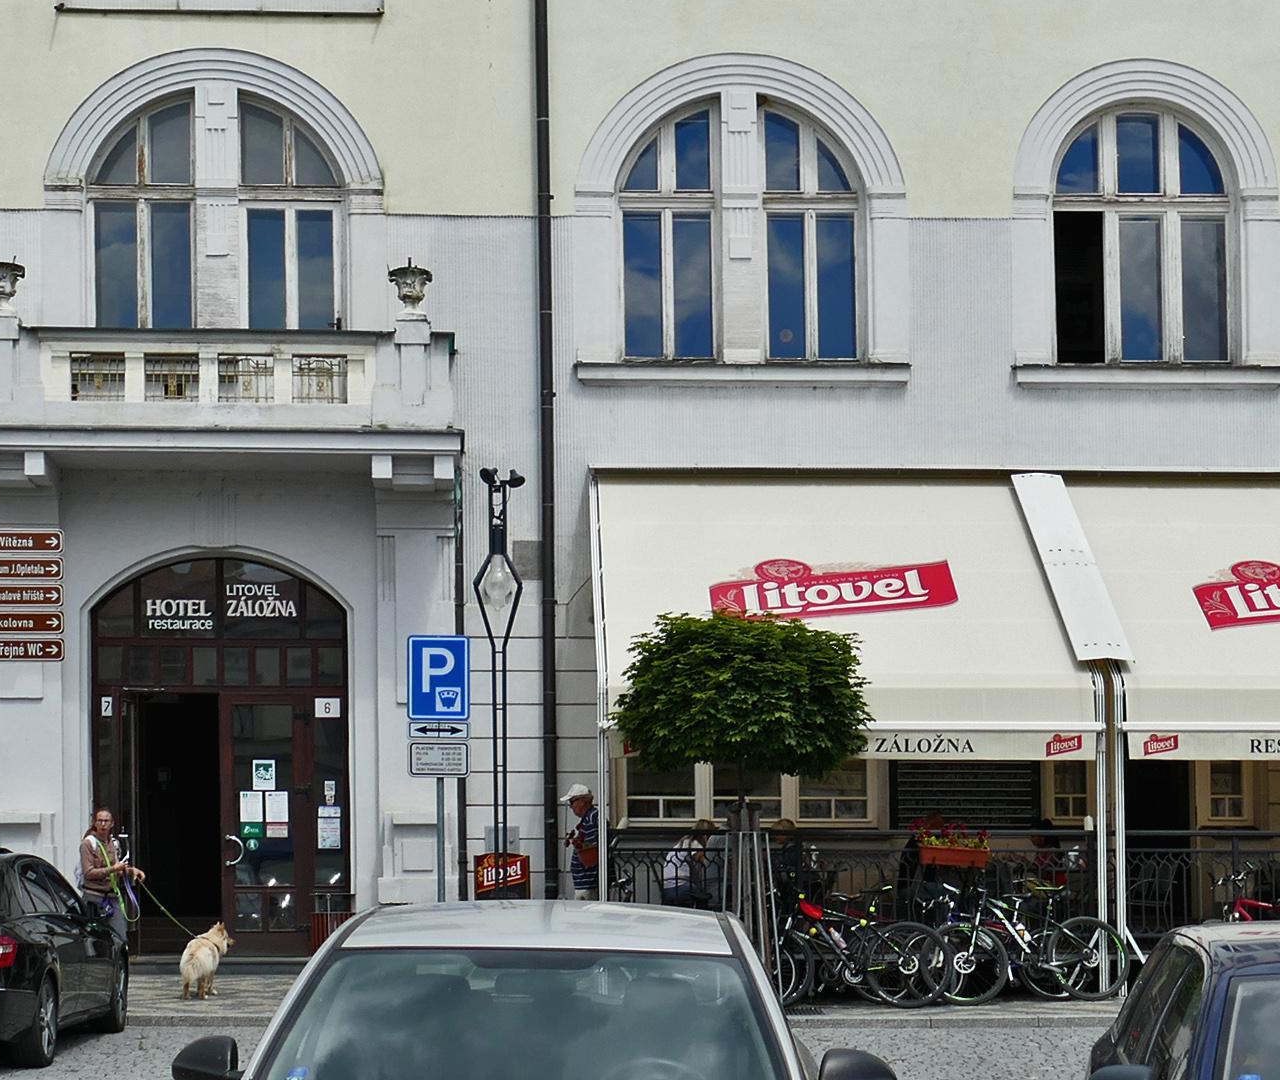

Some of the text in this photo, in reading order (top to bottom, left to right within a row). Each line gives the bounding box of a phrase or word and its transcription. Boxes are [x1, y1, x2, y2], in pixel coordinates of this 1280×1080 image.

[0, 536, 33, 548] Vítězná
[11, 563, 45, 576] J.Opletala
[22, 589, 44, 601] hřiště
[226, 584, 280, 596] LITOVEL
[741, 569, 930, 614] Litovel
[146, 599, 212, 617] HOTEL
[226, 597, 297, 617] ZÁLOŽNA
[149, 619, 213, 630] restaurace
[27, 643, 44, 656] WC
[422, 647, 455, 693] P
[324, 702, 331, 714] 6
[875, 733, 975, 754] ZÁLOŽNA
